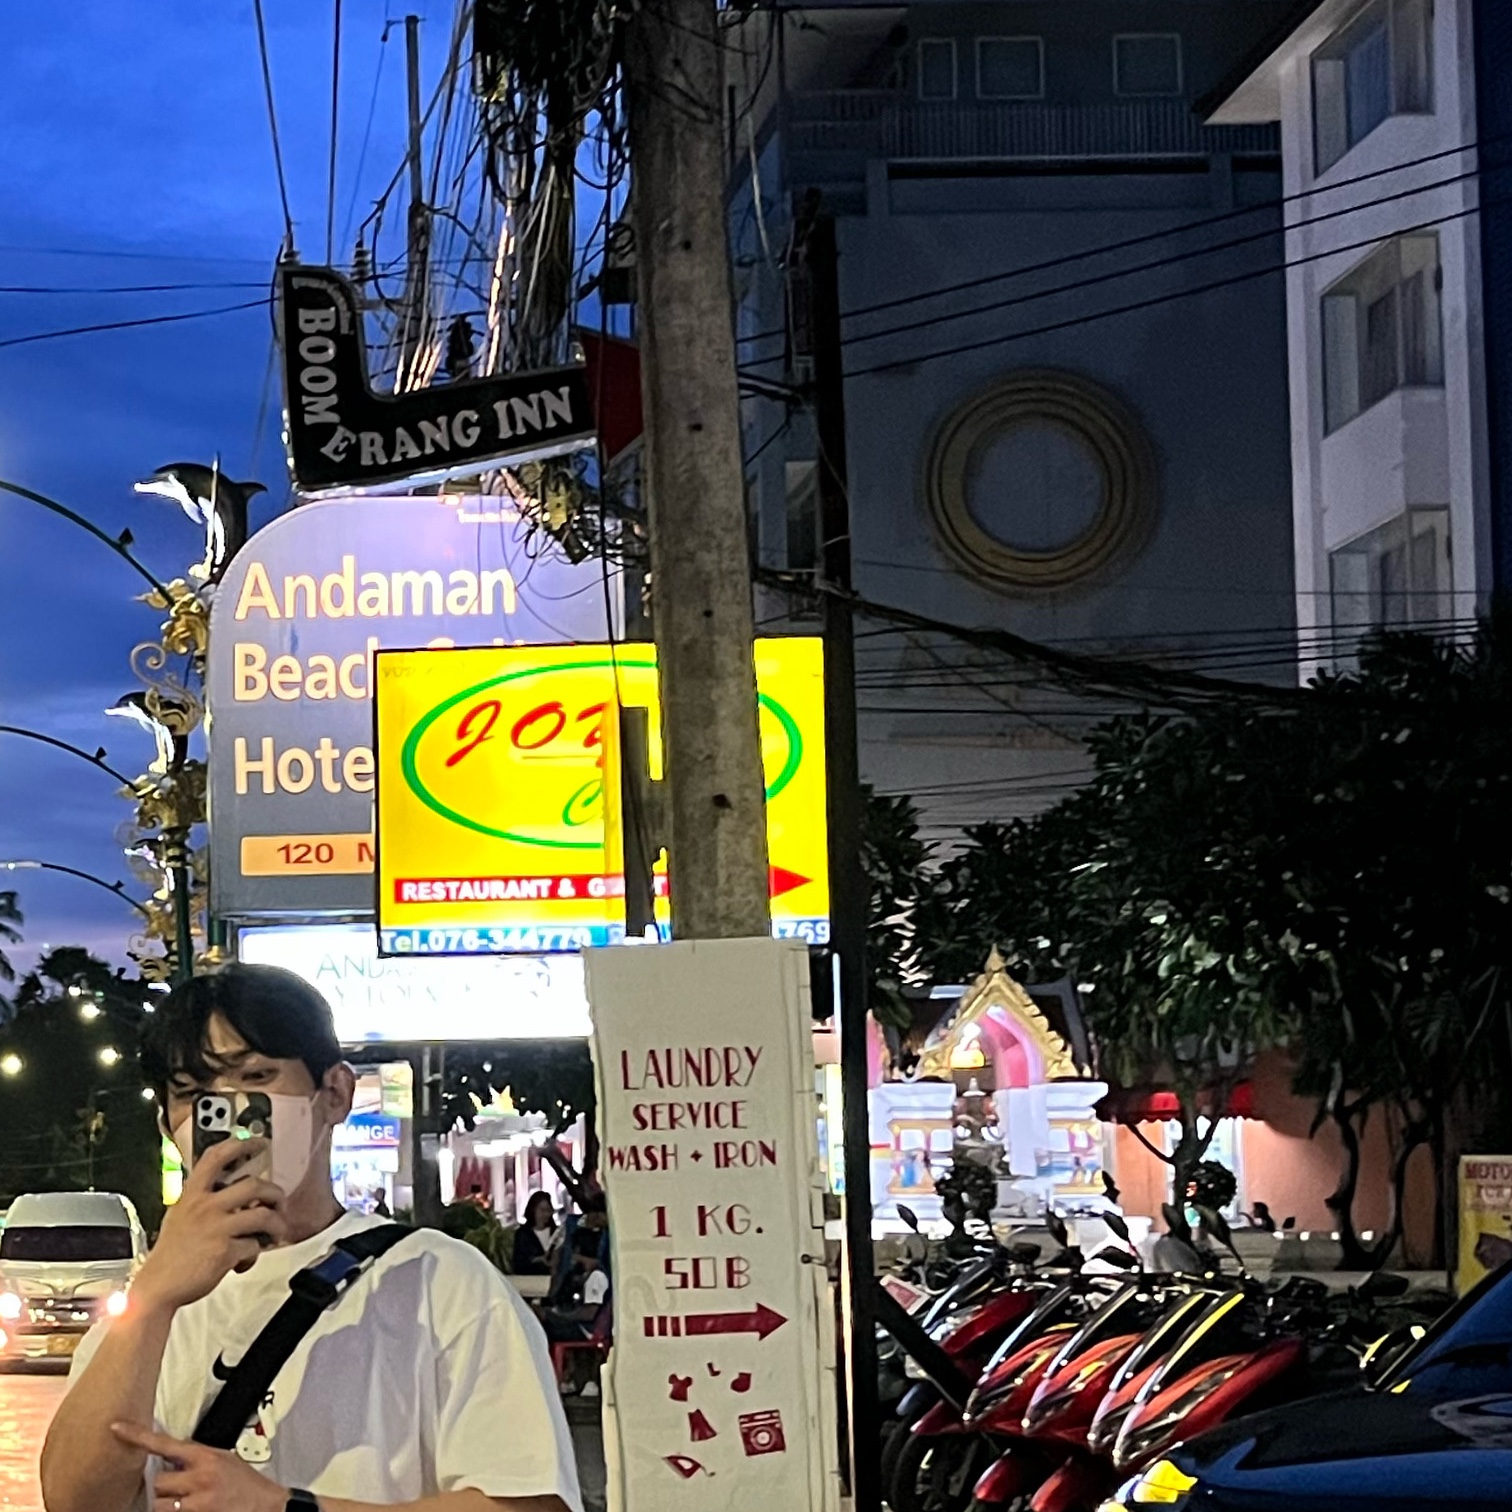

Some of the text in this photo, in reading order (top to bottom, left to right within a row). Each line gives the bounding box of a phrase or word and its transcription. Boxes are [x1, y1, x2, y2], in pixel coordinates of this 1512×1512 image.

[298, 306, 481, 466] BOOMERANG
[492, 386, 572, 439] INN
[234, 554, 518, 621] Andaman
[234, 736, 375, 794] Hote
[276, 842, 334, 864] 120
[402, 877, 552, 901] RESTAURANT
[558, 878, 575, 898] &
[621, 1045, 763, 1090] LAUNDRY
[632, 1100, 748, 1131] SERVICE
[608, 1143, 678, 1172] WASH
[713, 1139, 777, 1169] IRON
[649, 1203, 763, 1238] 1 KG.
